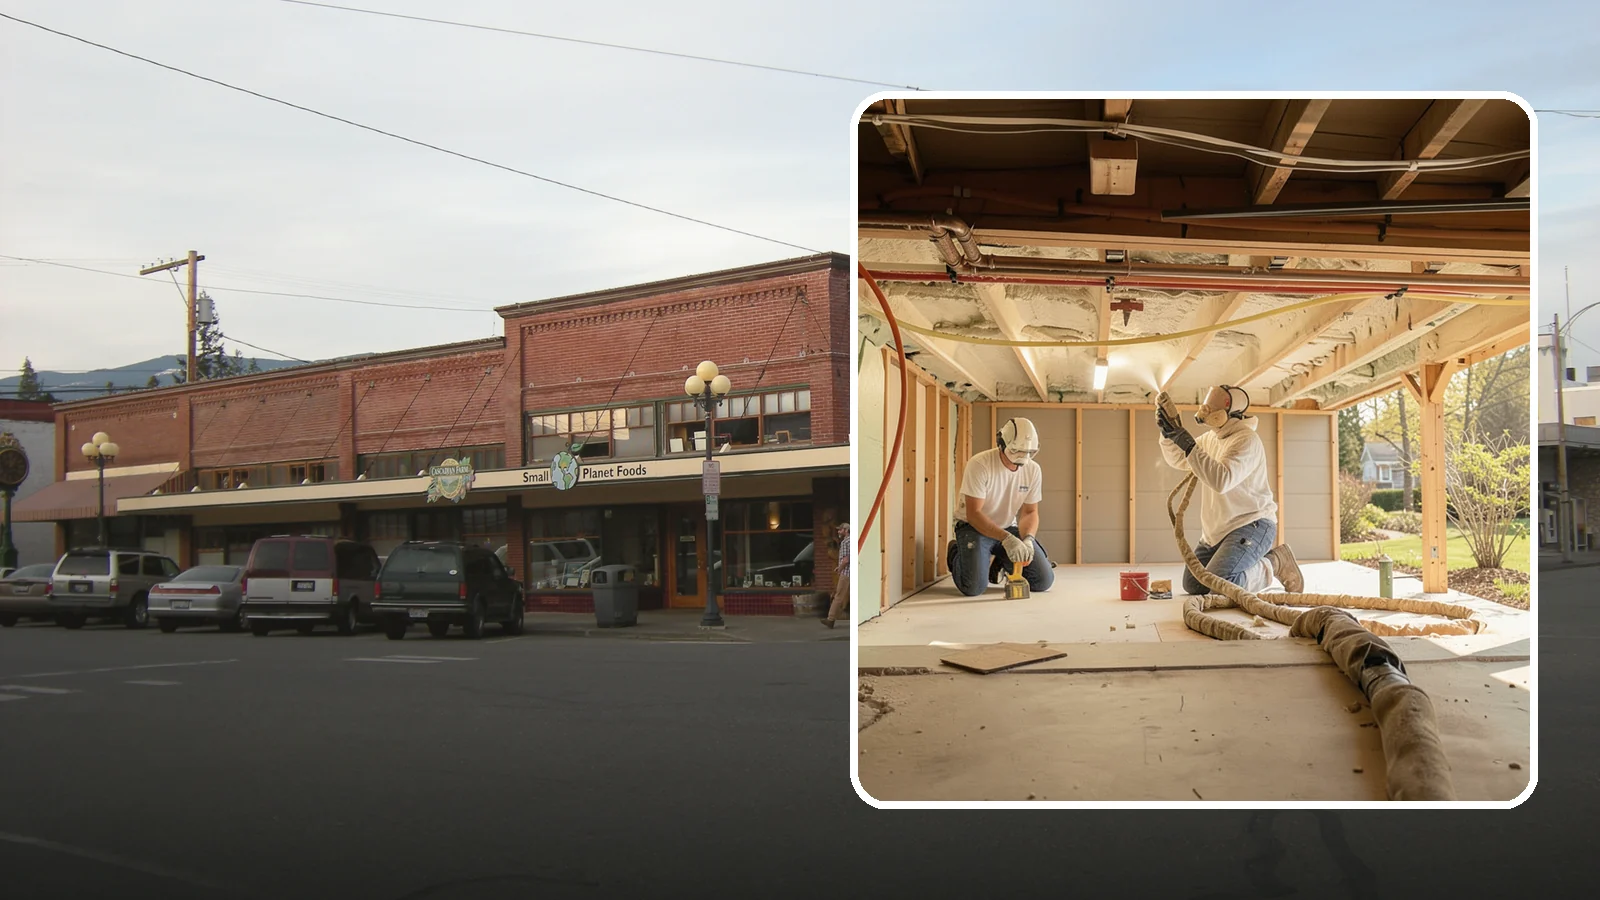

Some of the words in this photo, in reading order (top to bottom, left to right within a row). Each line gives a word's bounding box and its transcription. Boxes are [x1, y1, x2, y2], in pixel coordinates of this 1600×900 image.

[523, 471, 549, 482] Small
[583, 467, 614, 479] Planet
[617, 464, 647, 476] Foods
